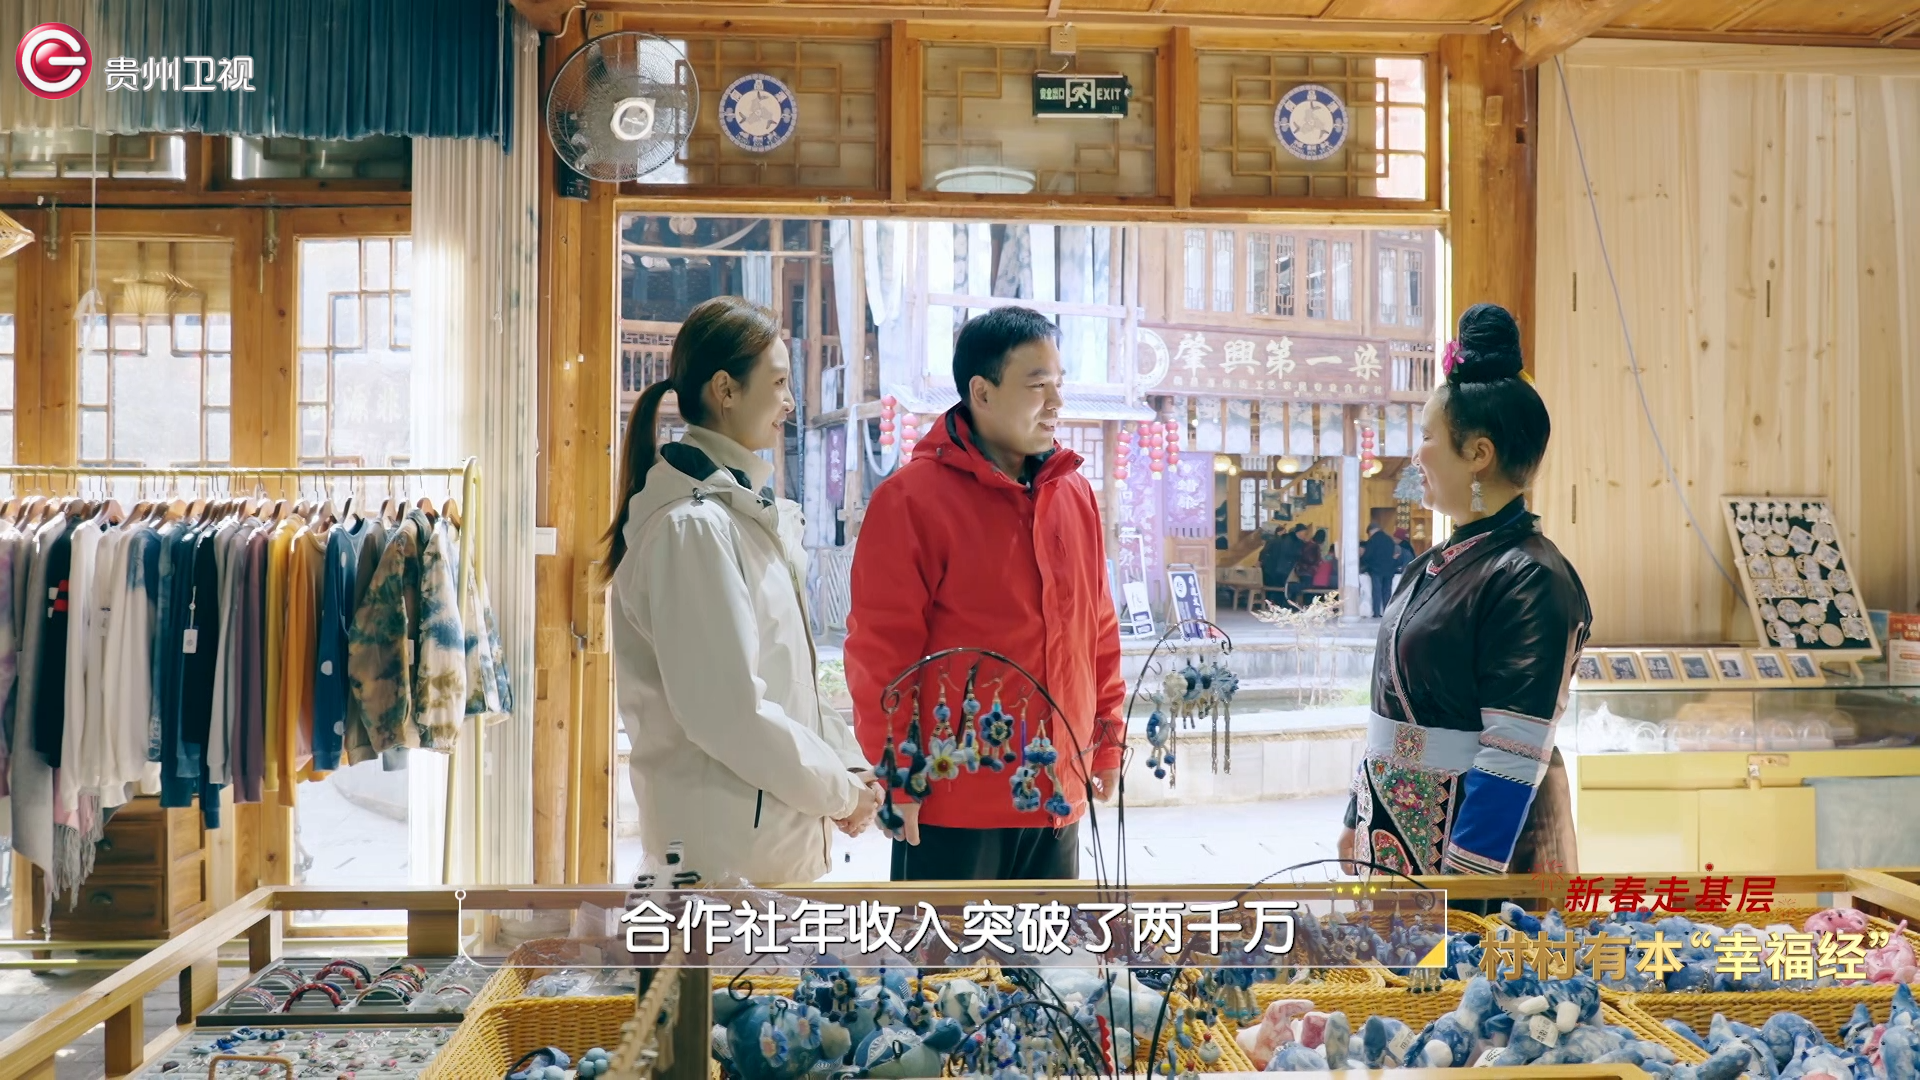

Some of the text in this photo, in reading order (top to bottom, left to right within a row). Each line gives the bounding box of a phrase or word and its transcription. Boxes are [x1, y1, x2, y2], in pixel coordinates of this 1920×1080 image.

[1096, 87, 1122, 100] EXIT
[1174, 331, 1383, 381] 肇興第一染
